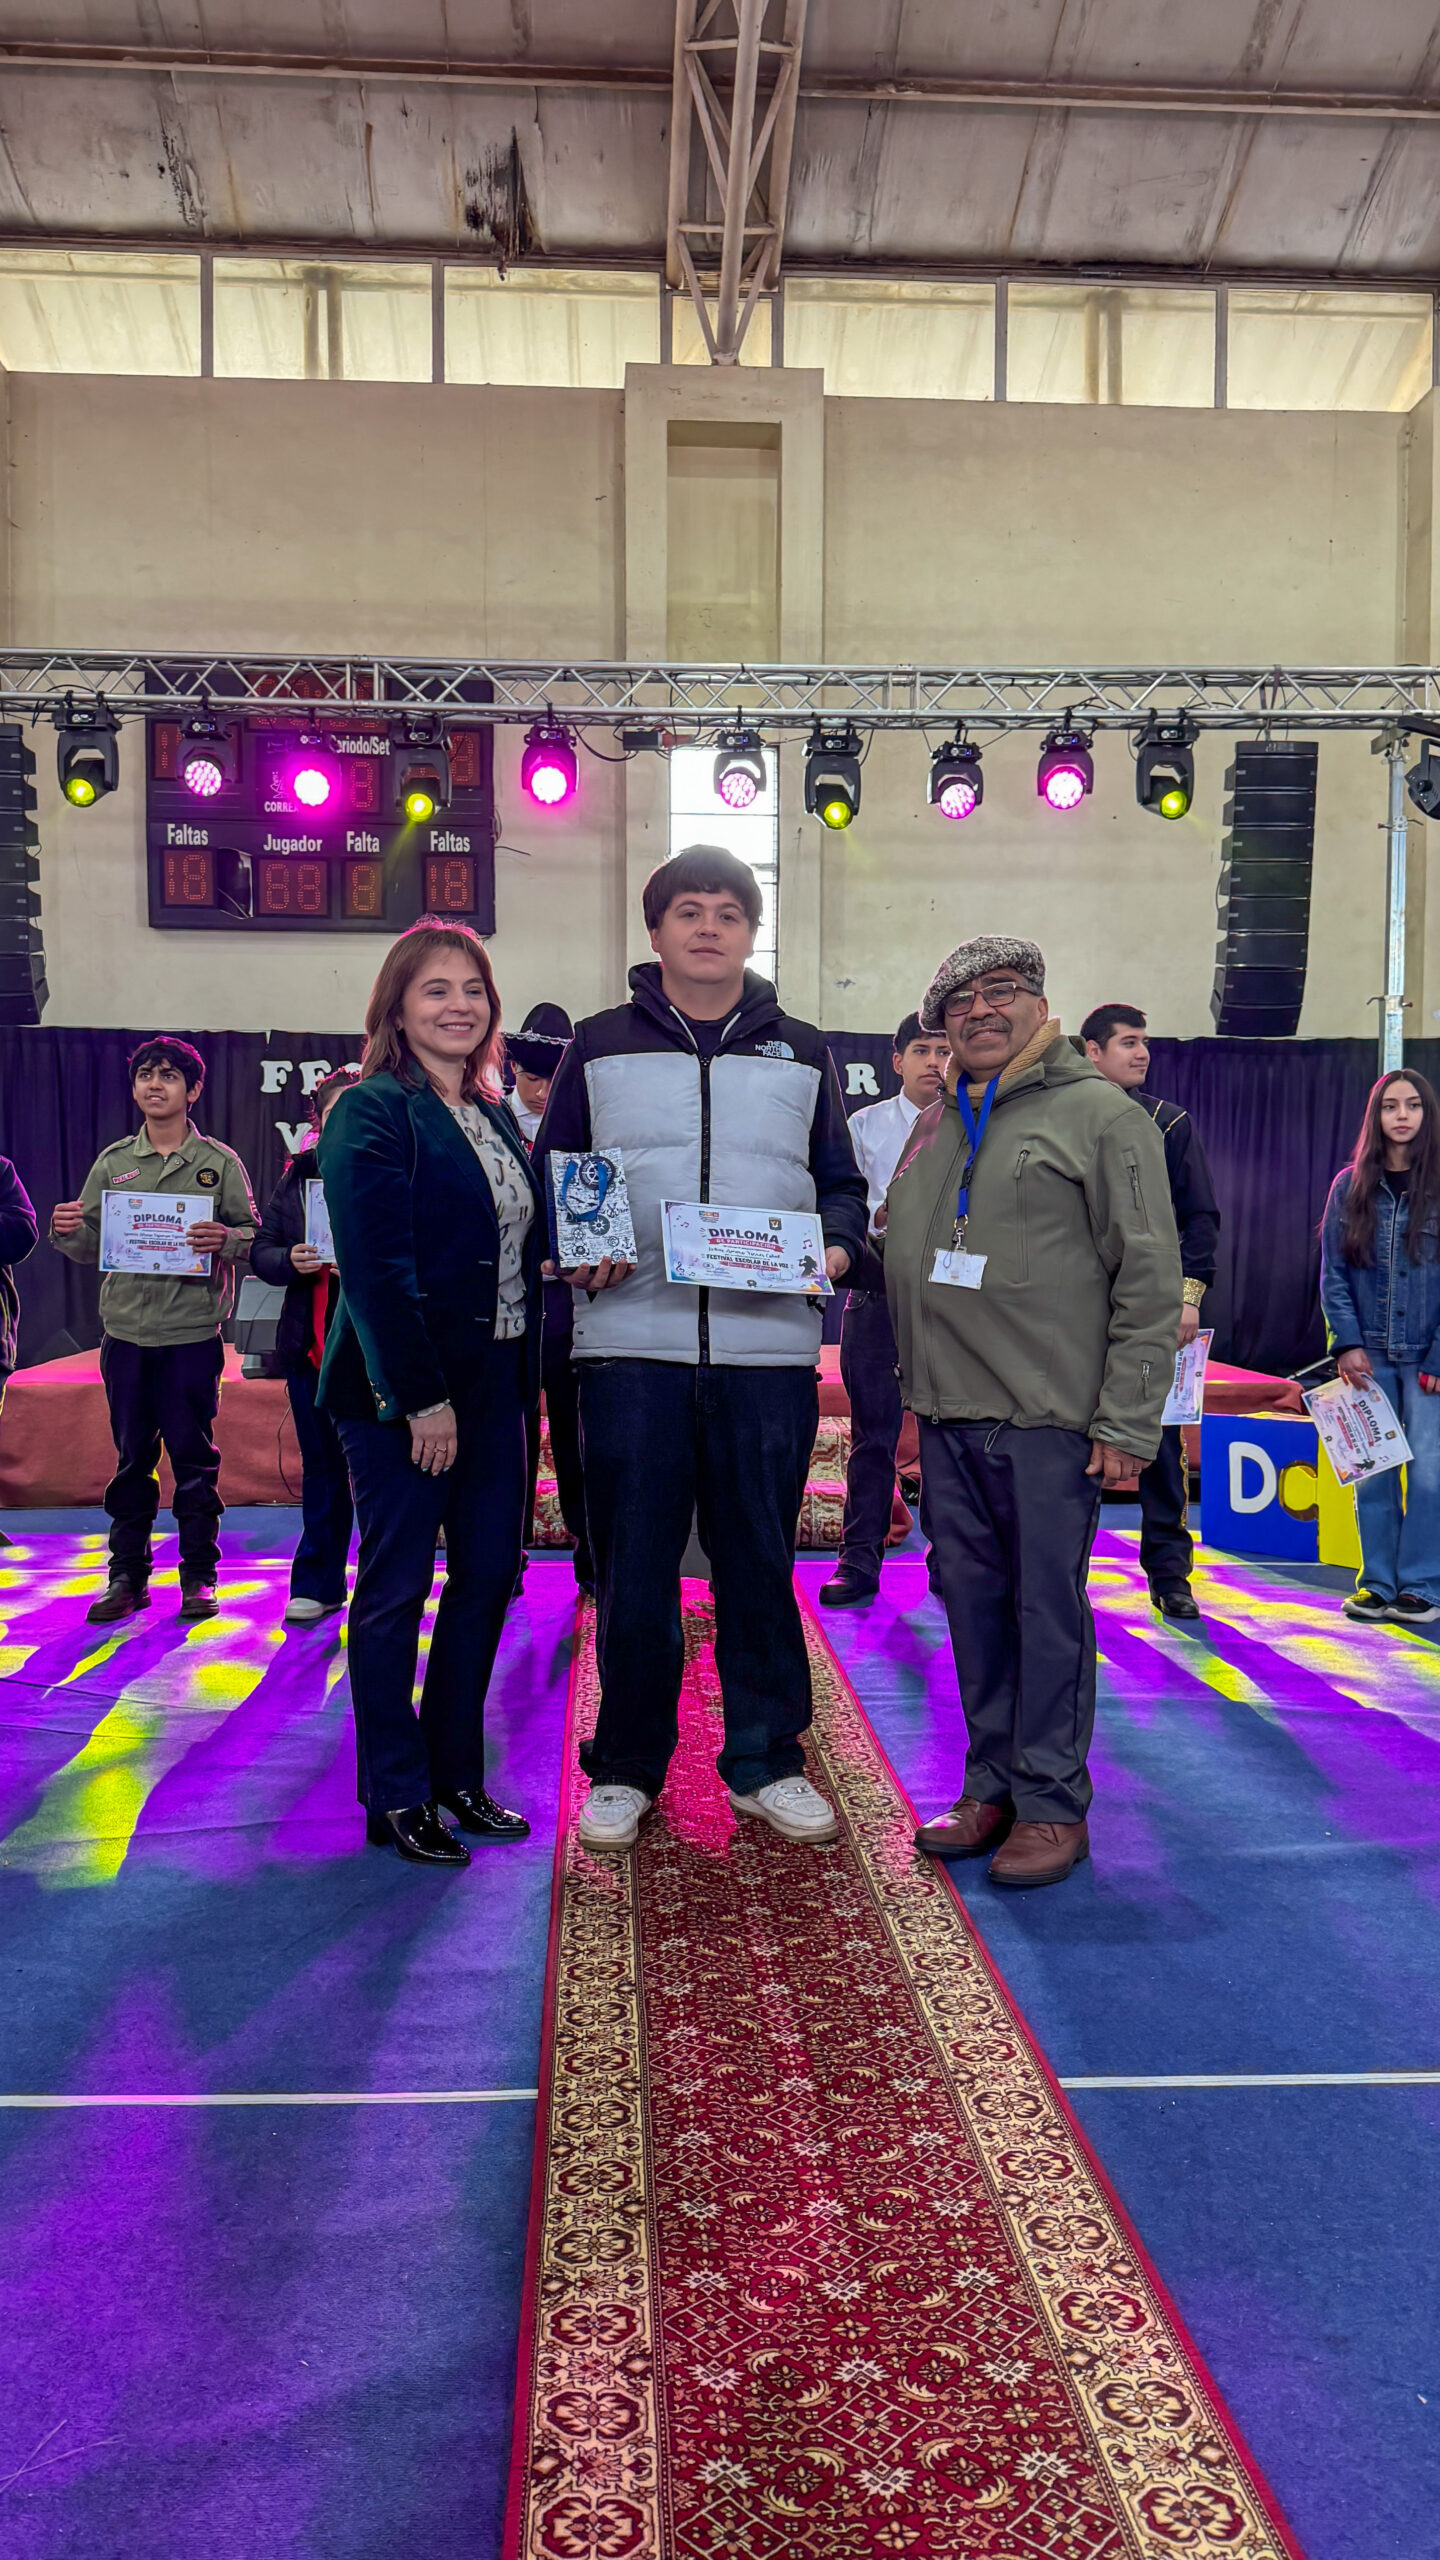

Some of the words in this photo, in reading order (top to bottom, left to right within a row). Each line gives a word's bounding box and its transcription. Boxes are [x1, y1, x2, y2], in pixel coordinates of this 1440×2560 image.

[166, 823, 209, 846] Faltas
[263, 833, 323, 855] Jugador
[346, 830, 380, 853] Falta
[430, 830, 471, 852] Faltas
[755, 1044, 781, 1052] NORTH
[133, 1213, 182, 1224] DIPLOMA
[708, 1228, 779, 1244] DIPLOMA
[706, 1253, 733, 1261] FESTIVAL
[735, 1257, 761, 1265] ESCOLAR
[1358, 1399, 1382, 1443] DIPLOMA
[1229, 1441, 1277, 1514] D
